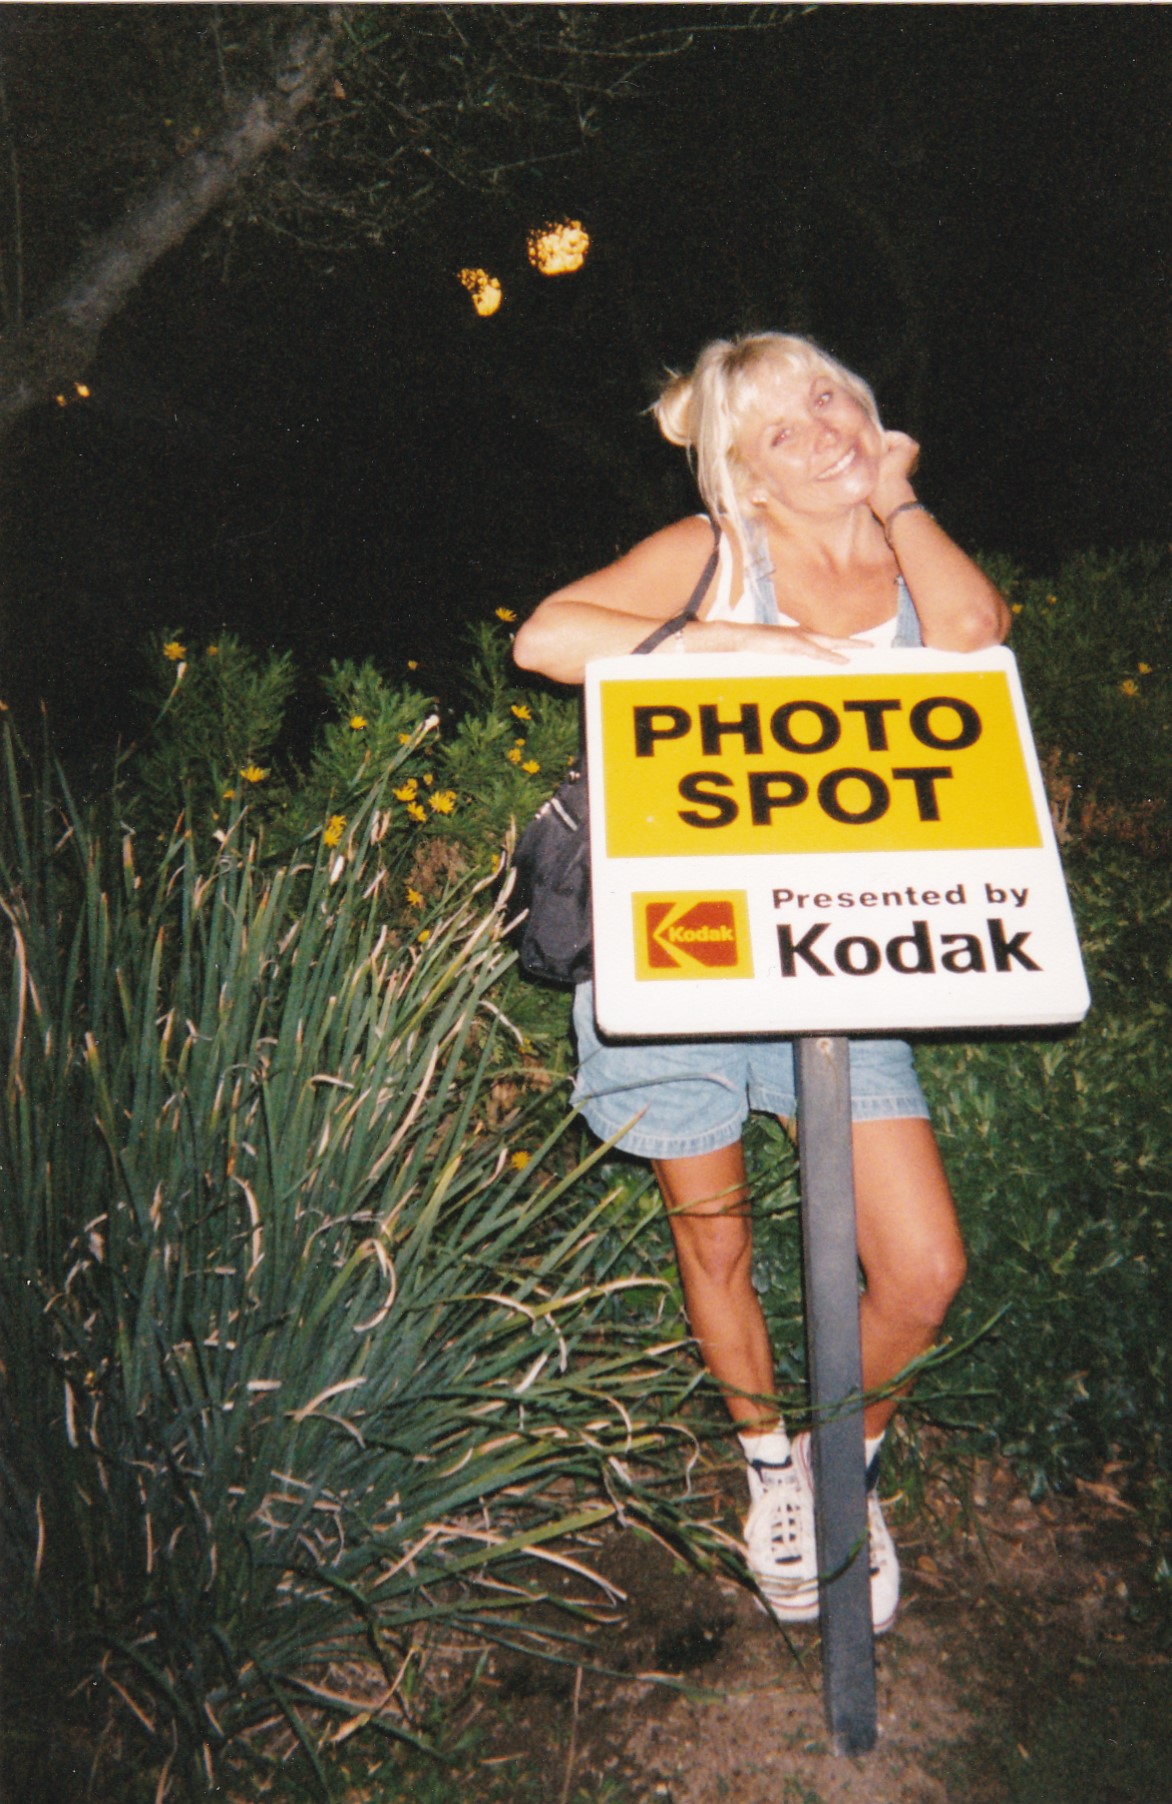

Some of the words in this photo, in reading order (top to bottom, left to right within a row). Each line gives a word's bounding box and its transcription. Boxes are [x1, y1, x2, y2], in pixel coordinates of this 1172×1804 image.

[632, 696, 982, 757] PHOTO
[677, 766, 954, 828] SPOT
[772, 883, 967, 909] Presented
[984, 883, 1030, 908] by
[668, 925, 734, 942] Kodak
[775, 918, 1043, 978] Kodak
